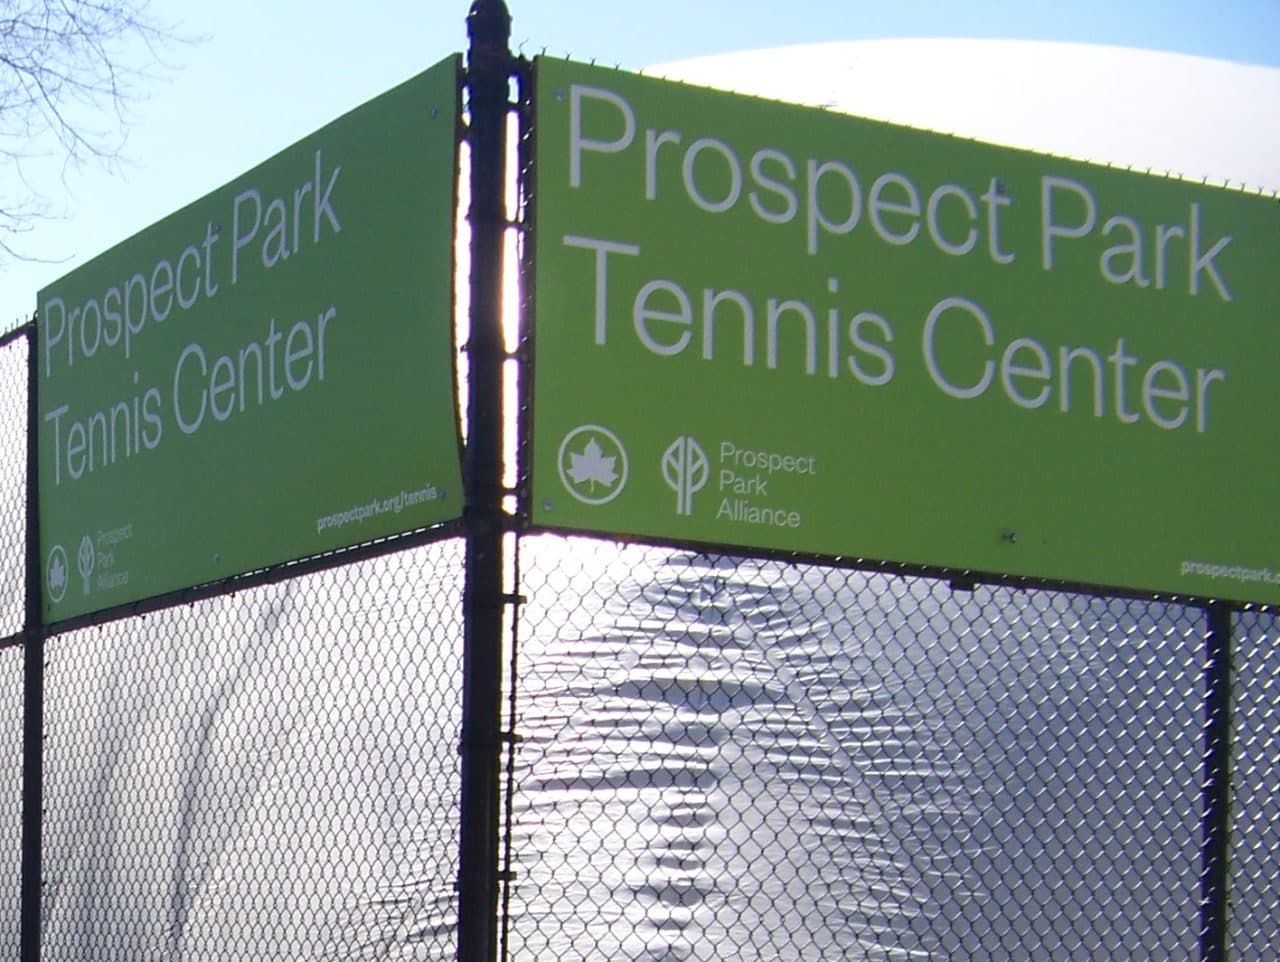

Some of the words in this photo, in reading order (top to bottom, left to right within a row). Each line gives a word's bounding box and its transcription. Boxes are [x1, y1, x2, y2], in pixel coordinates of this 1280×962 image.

[568, 83, 1015, 265] Prospect
[1040, 175, 1233, 302] Park
[44, 222, 220, 377] Prospect
[231, 150, 342, 285] Park
[563, 235, 896, 387] Tennis
[921, 296, 1225, 433] Center
[45, 370, 162, 486] Tennis
[174, 306, 336, 434] Center
[317, 484, 437, 535] prospectpark.org/tennis
[716, 498, 801, 528] Alliance
[720, 441, 816, 475] Prospect
[720, 469, 768, 496] Park
